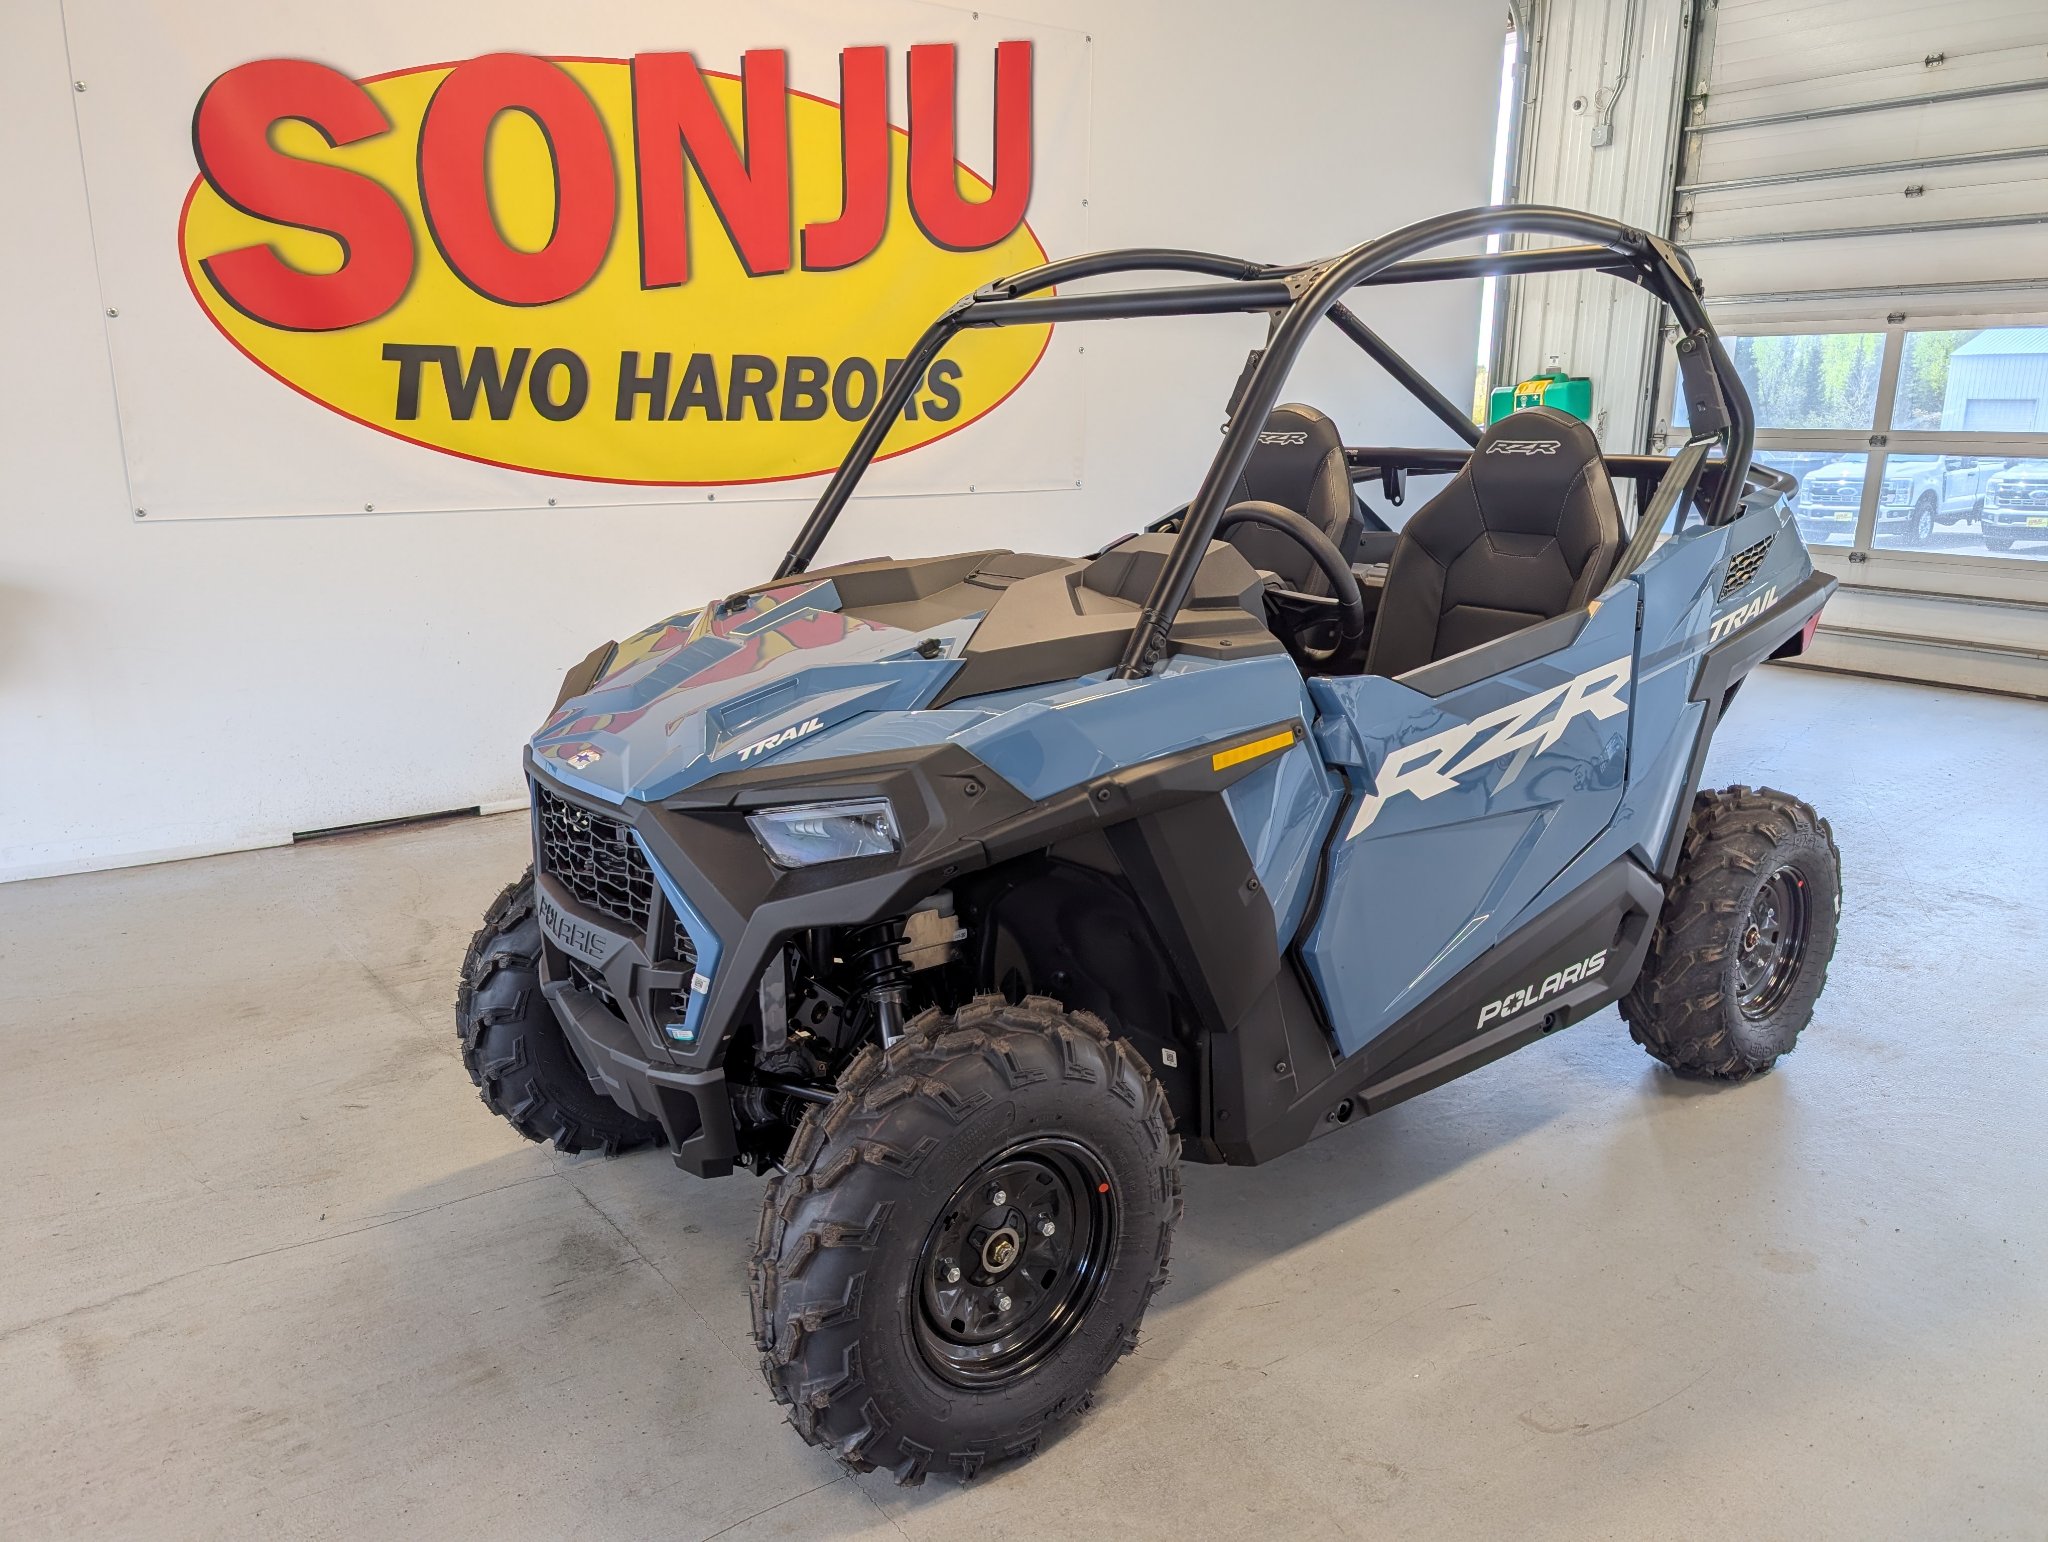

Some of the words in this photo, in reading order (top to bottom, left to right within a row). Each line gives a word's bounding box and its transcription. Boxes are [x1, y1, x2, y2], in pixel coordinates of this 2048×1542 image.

[192, 41, 1033, 331] SONJU
[382, 343, 588, 422] TWO
[1486, 440, 1561, 455] RZR
[1710, 585, 1779, 643] TRAIL
[738, 718, 824, 761] TRAIL
[1345, 655, 1632, 841] RZR
[539, 896, 606, 960] POLARIS
[1477, 949, 1608, 1030] POLARIS
